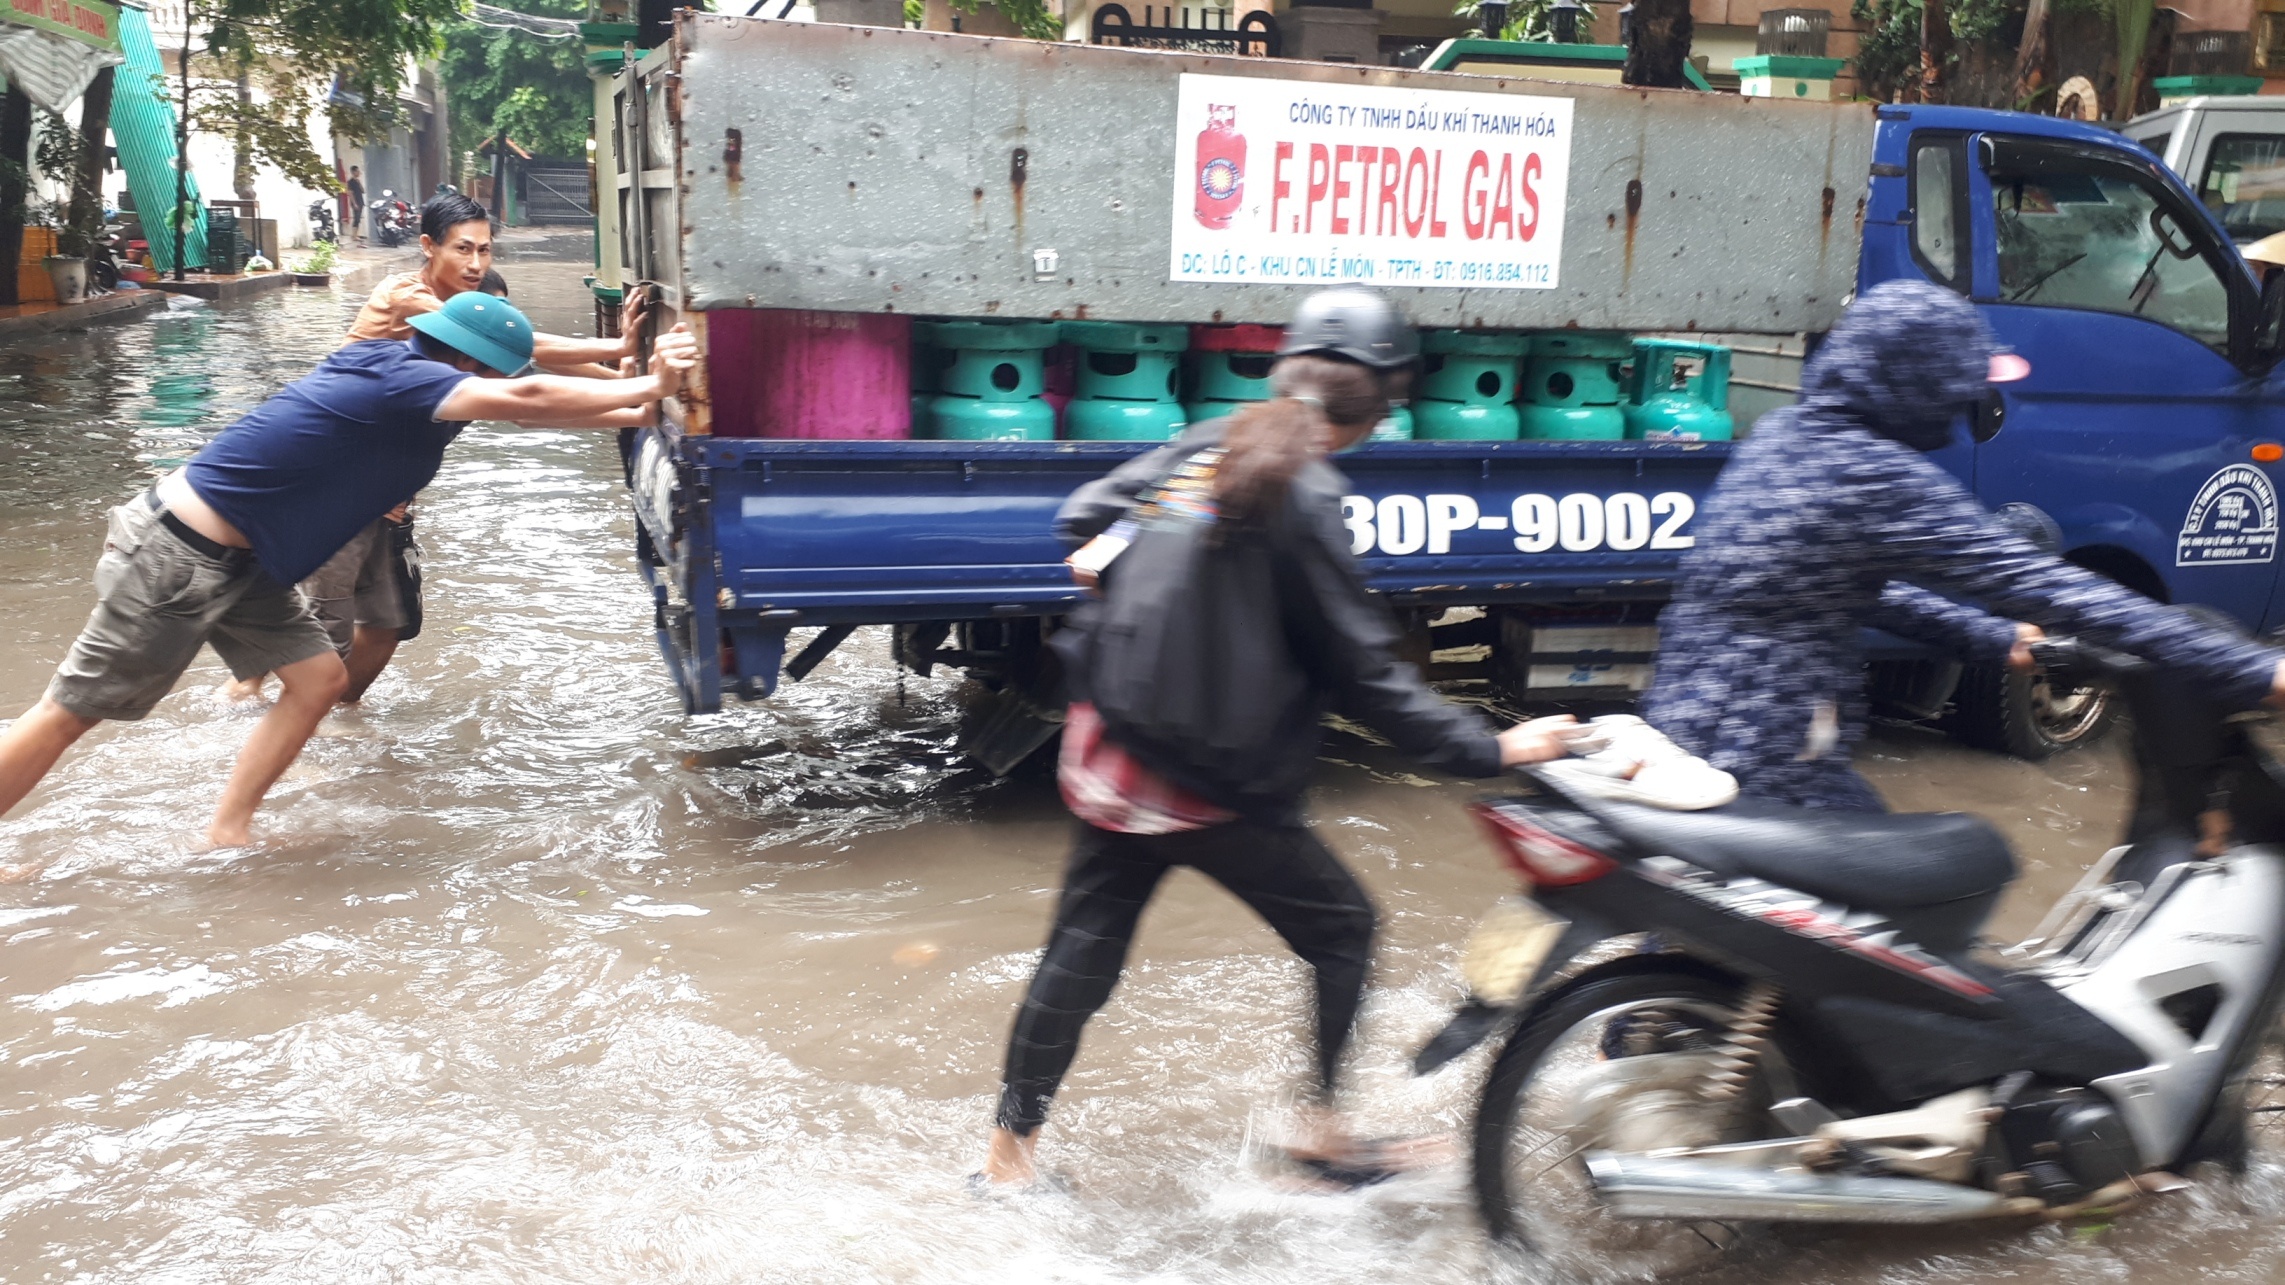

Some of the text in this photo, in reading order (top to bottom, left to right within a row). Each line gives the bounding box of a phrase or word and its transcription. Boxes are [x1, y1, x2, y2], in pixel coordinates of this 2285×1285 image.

[1290, 97, 1556, 138] CÔNG TY TNHH DẦU KHÍ THANH HÓA
[1269, 141, 1447, 239] F.PETROL
[1462, 149, 1542, 242] GAS
[1236, 254, 1247, 275] C
[1259, 256, 1290, 276] KHU
[1295, 256, 1316, 277] CN
[1387, 259, 1422, 280] TPTH
[1460, 261, 1550, 283] 0916.854.112
